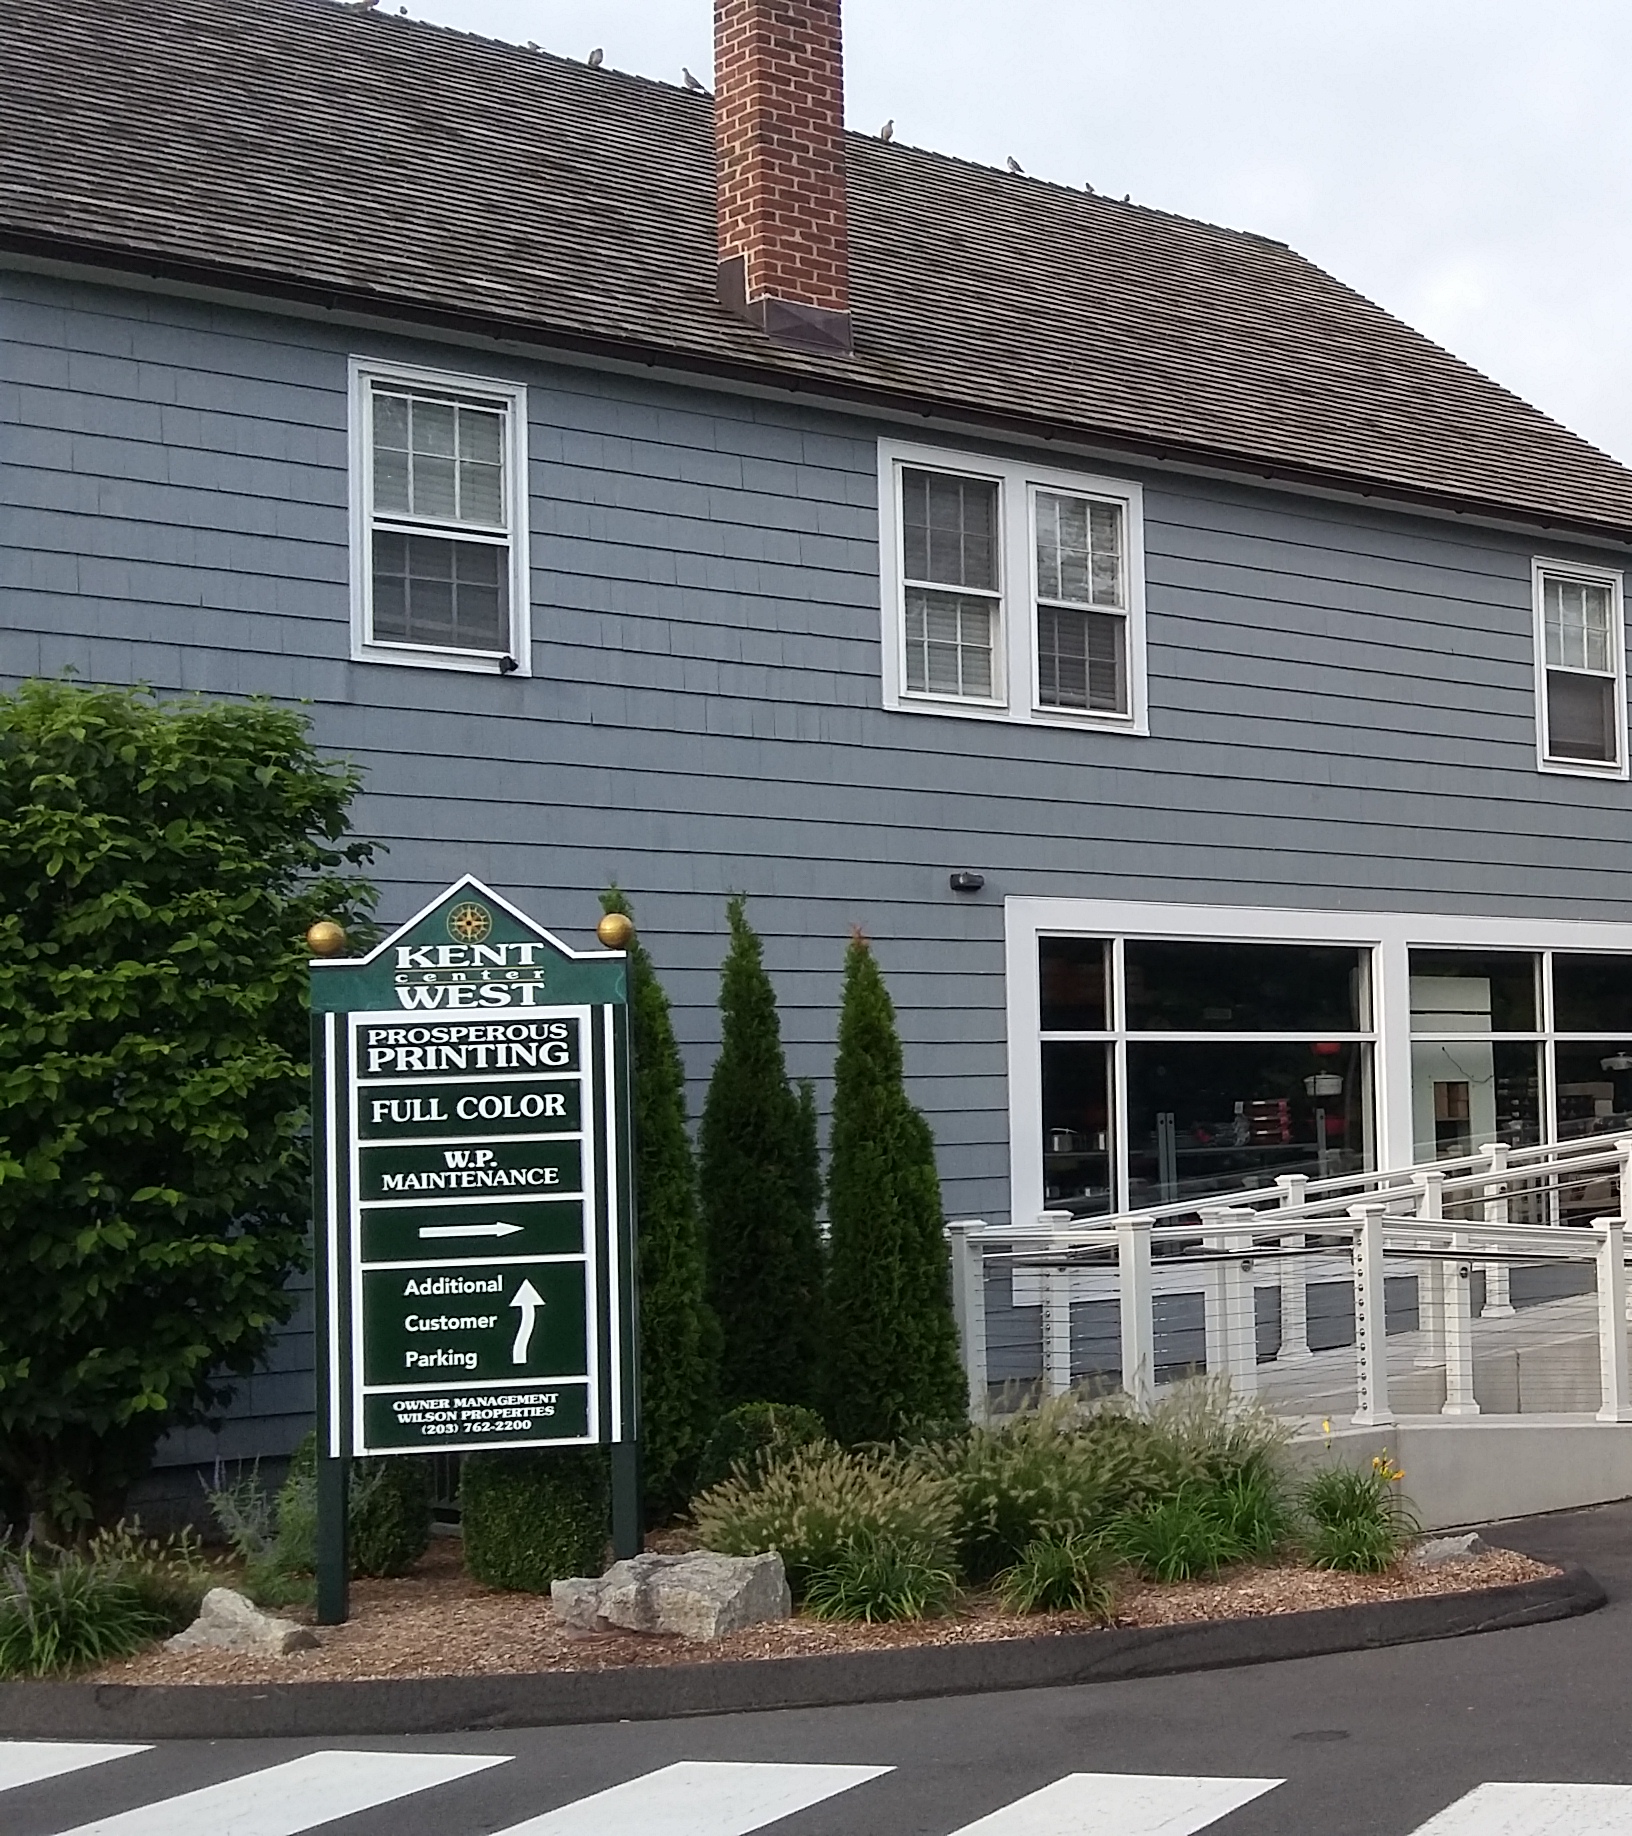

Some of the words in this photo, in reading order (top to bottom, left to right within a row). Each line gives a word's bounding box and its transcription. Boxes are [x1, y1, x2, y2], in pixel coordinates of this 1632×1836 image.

[395, 943, 544, 968] KENT
[395, 968, 545, 982] center
[395, 982, 545, 1009] WEST
[367, 1023, 568, 1046] PROSPEROUS
[367, 1042, 570, 1073] PRINTING
[371, 1098, 448, 1123] FULL
[456, 1093, 567, 1120] COLOR
[443, 1149, 498, 1169] W.P.
[381, 1167, 560, 1191] MAINTENANCE
[403, 1275, 503, 1297] Additional
[404, 1314, 498, 1332] Customer
[405, 1349, 478, 1369] Parking
[392, 1398, 451, 1411] OWNER
[453, 1393, 559, 1408] MANAGEMENT
[397, 1410, 458, 1424] WILSON
[460, 1405, 555, 1420] PROPERTIES
[421, 1423, 459, 1436] (203)
[463, 1418, 532, 1433] 762-2200
